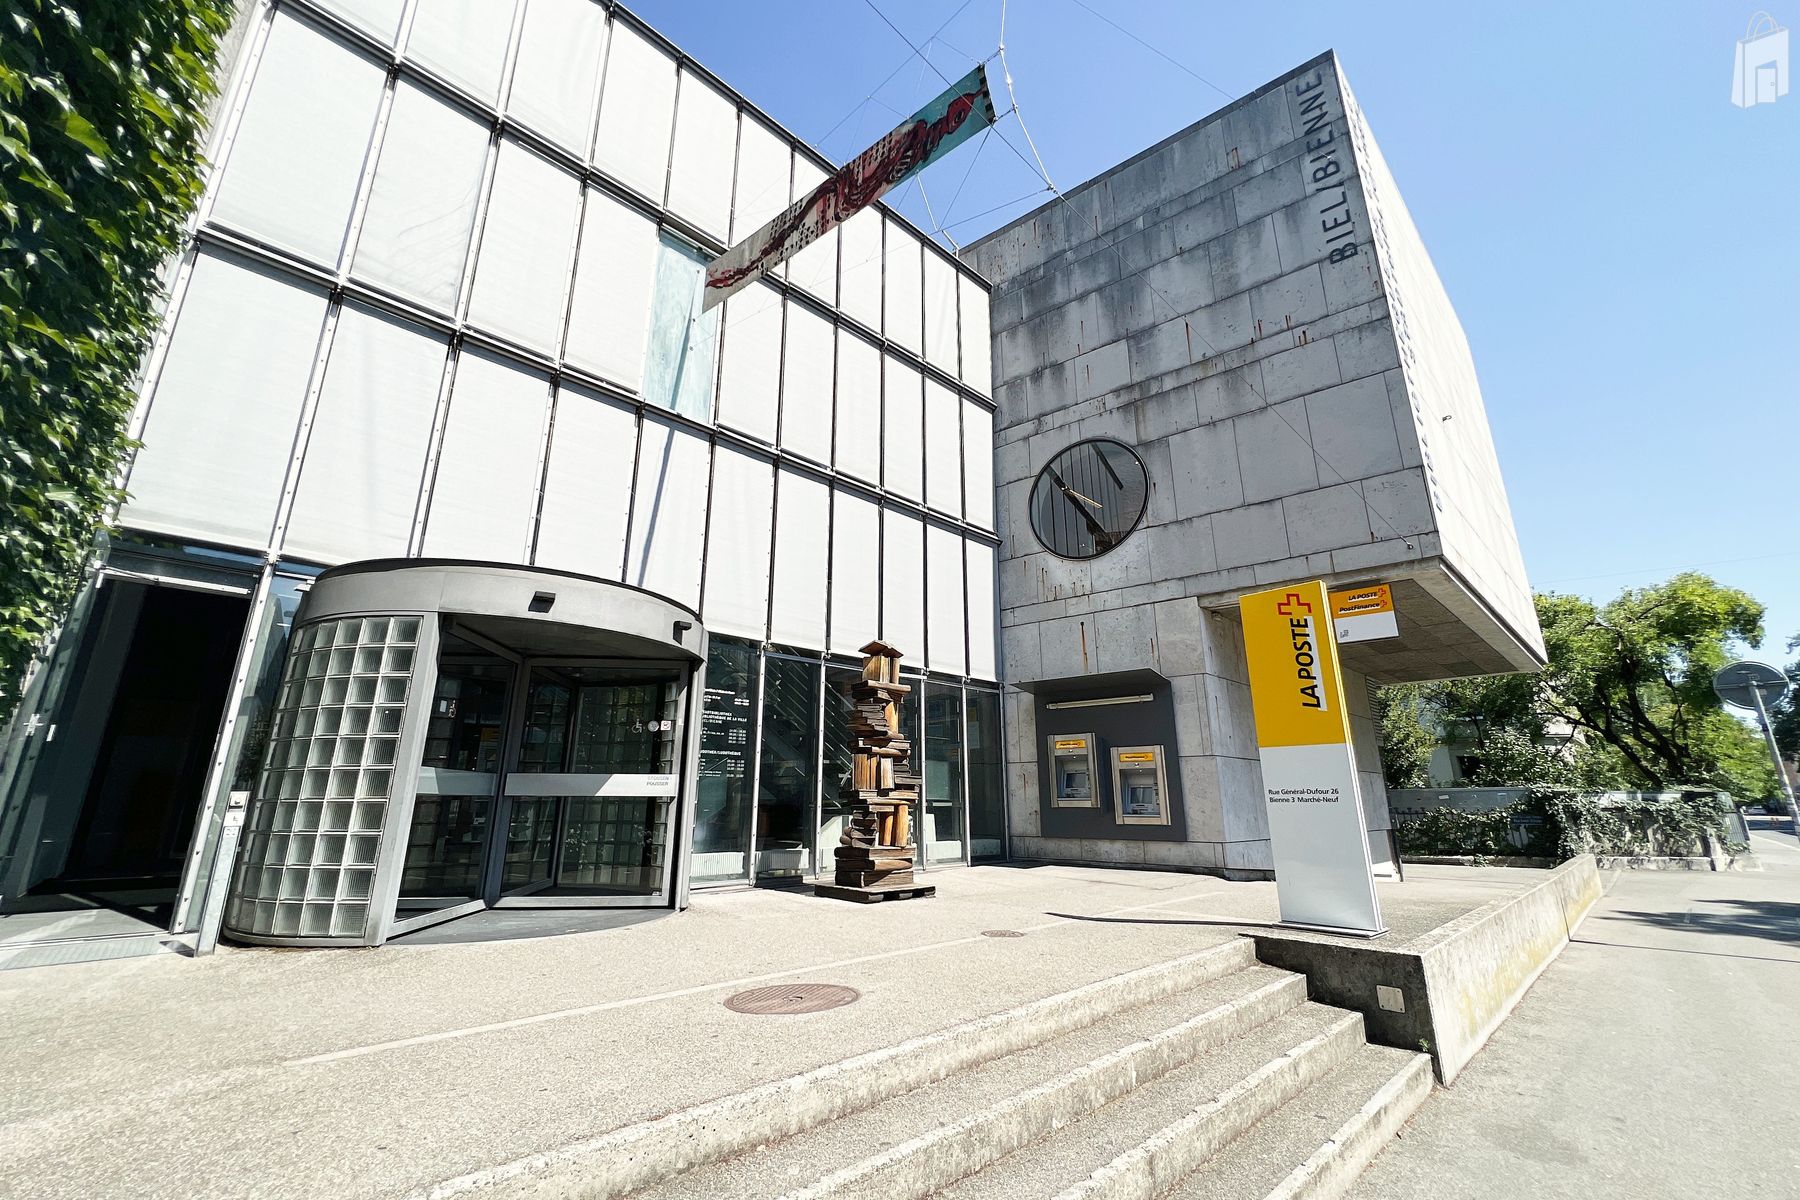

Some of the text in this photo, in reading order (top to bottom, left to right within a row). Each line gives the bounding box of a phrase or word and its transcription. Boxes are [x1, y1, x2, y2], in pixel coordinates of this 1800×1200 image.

[1357, 592, 1378, 600] POSTE
[1339, 603, 1380, 612] PostFinance
[1290, 618, 1321, 708] LA POSTE
